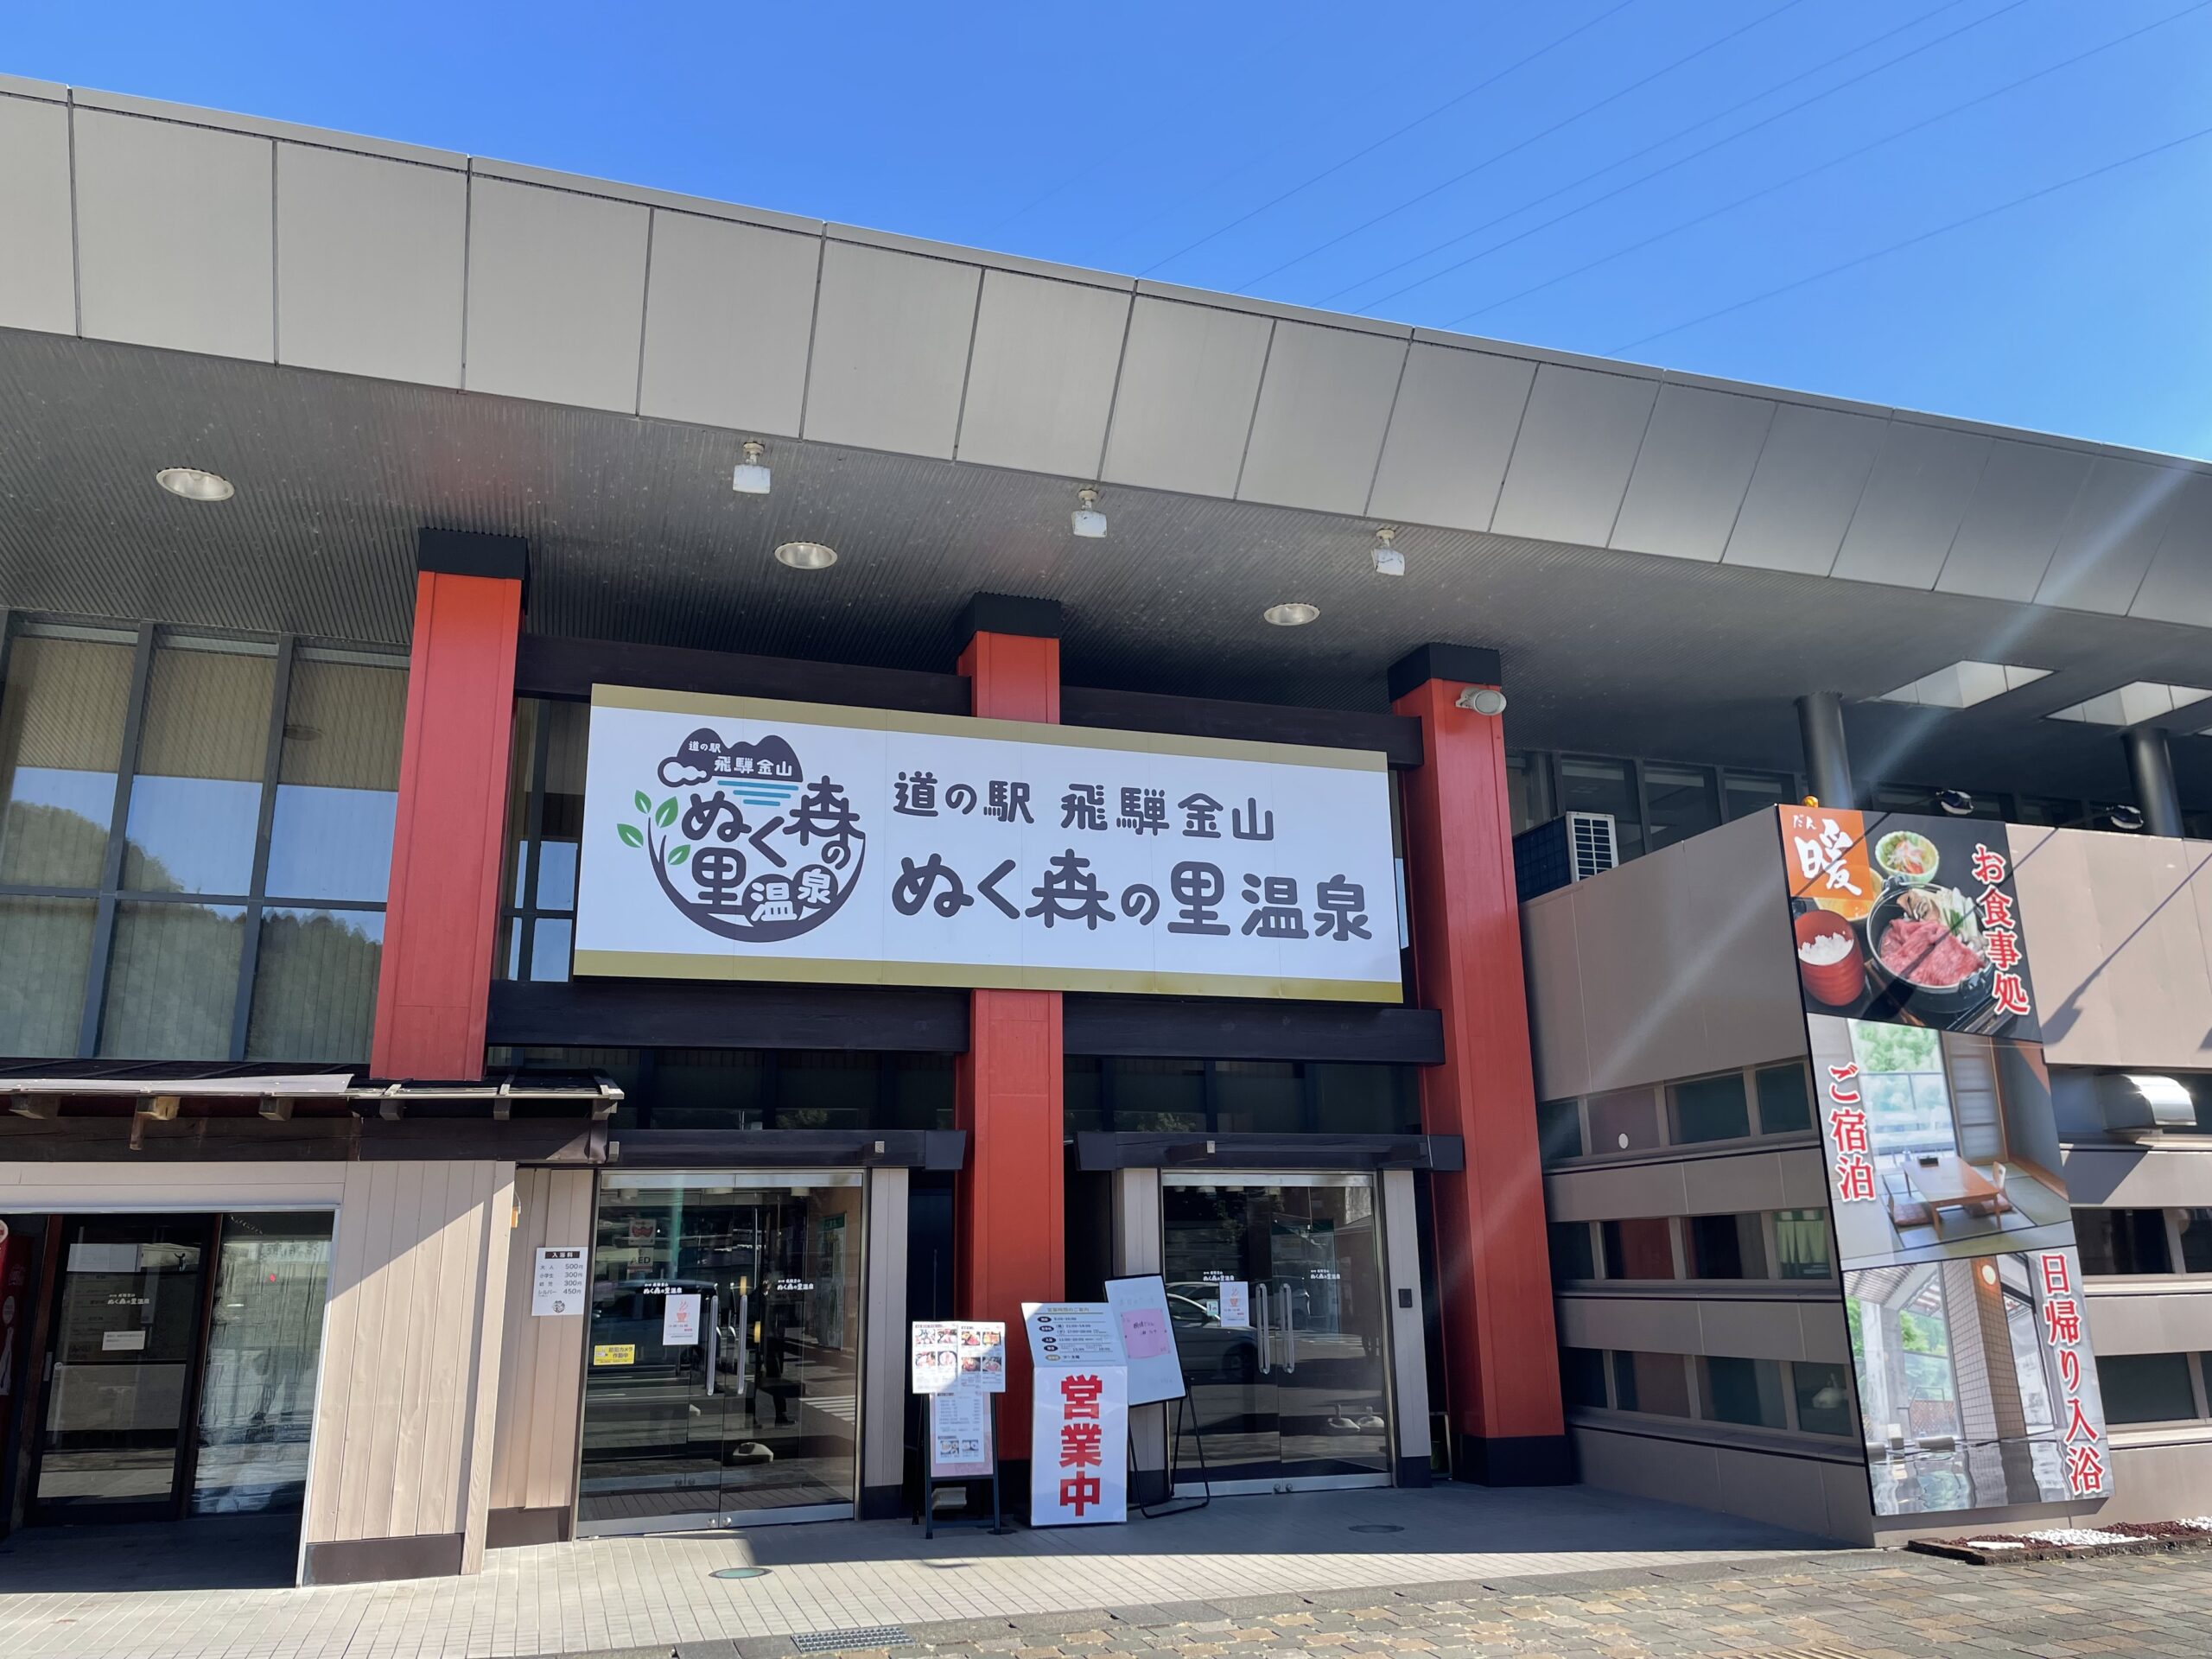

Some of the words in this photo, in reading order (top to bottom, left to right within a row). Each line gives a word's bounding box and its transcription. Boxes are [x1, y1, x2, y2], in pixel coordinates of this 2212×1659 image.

[688, 741, 721, 753] 道の駅
[714, 755, 792, 776] 飛騨金山
[893, 771, 1035, 824] 道の駅
[1060, 783, 1274, 842] 飛騨金山
[1793, 814, 1817, 830] だん
[892, 849, 1373, 942] ぬく森の里温泉
[1971, 842, 2031, 1016] お食事処
[1827, 1063, 1876, 1203] ご宿泊
[2040, 1252, 2104, 1495] 日帰り入浴
[1059, 1374, 1103, 1517] 営業中
